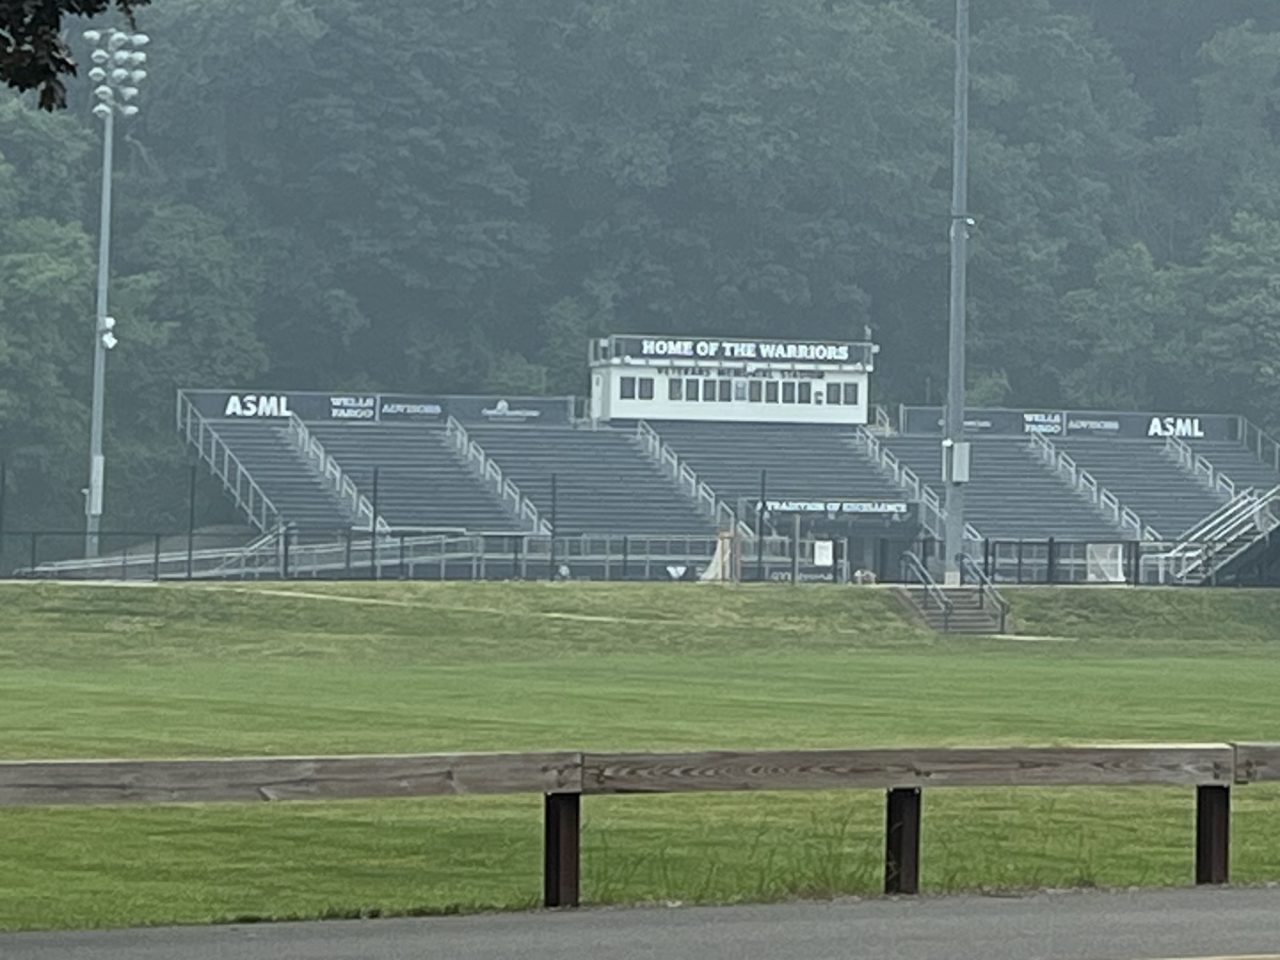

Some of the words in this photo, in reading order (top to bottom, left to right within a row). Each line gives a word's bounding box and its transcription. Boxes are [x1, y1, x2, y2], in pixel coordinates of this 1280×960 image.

[642, 340, 693, 356] HOME
[696, 341, 718, 356] OF
[722, 342, 757, 358] THE
[760, 343, 849, 360] WARRIORS
[225, 395, 293, 417] ASML
[330, 397, 374, 407] WELLS
[331, 408, 374, 418] FARGO
[1148, 417, 1204, 437] ASML
